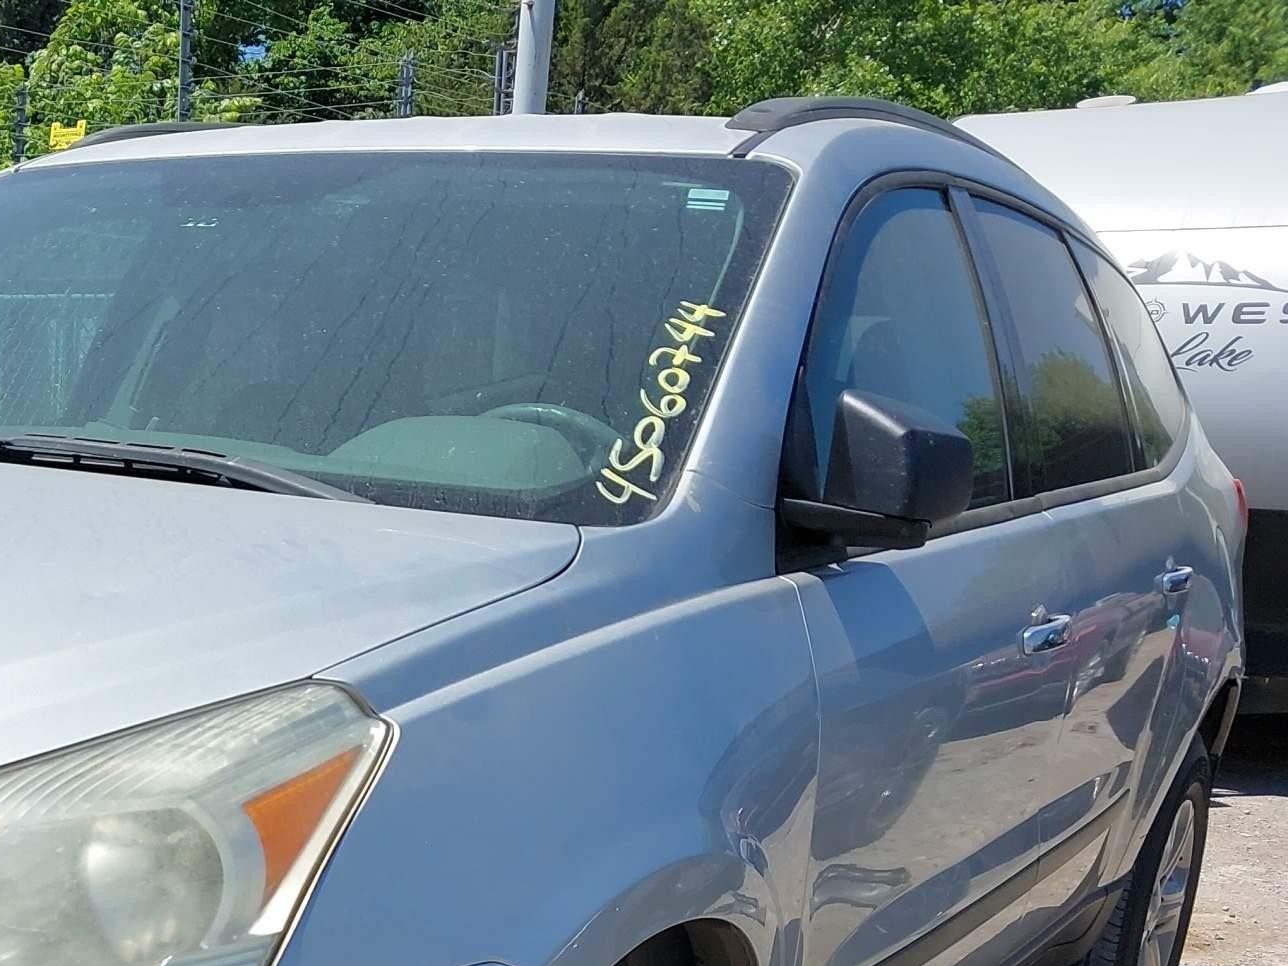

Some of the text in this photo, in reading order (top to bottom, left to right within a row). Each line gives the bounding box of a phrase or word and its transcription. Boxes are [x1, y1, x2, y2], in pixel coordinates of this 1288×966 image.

[1182, 302, 1288, 324] WE
[1171, 331, 1254, 373] Lake
[596, 301, 726, 504] 45060744
